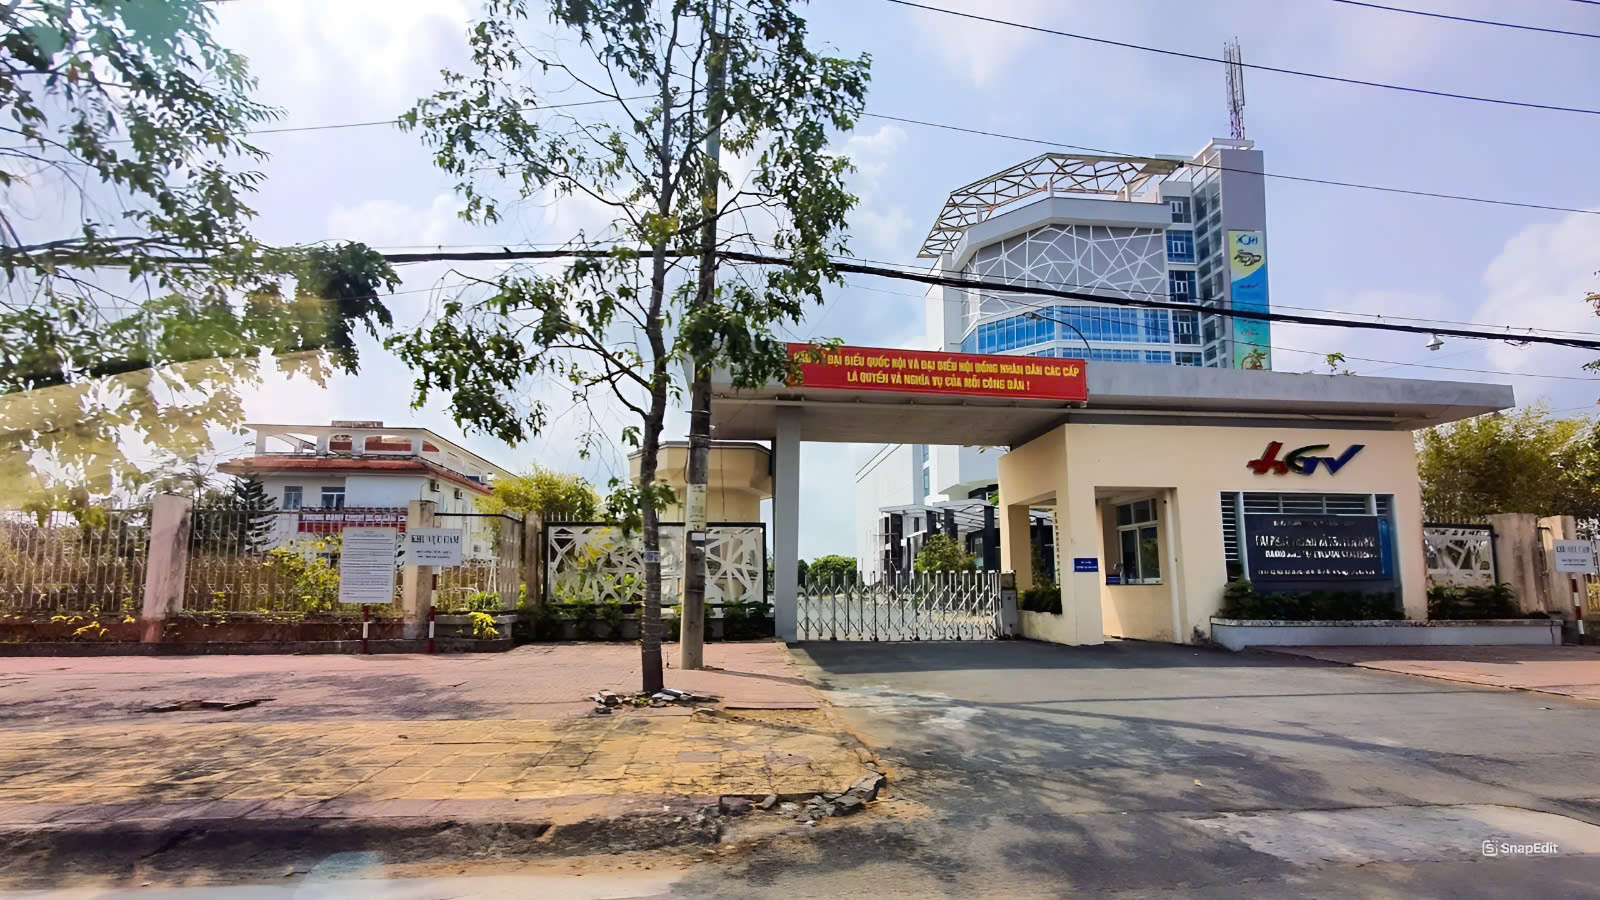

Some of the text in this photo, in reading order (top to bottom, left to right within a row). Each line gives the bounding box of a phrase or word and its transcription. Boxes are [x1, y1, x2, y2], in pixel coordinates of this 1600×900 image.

[827, 354, 842, 367] ĐẠI
[844, 352, 865, 366] BIỂU
[867, 354, 890, 367] QUỐC
[891, 356, 906, 370] HỘI
[907, 357, 920, 369] VÀ
[921, 359, 935, 372] ĐẠI
[937, 357, 957, 371] BIỂU
[958, 360, 973, 374] HỘI
[1000, 362, 1023, 375] NHÂN
[1025, 363, 1042, 376] DÂN
[1044, 365, 1061, 377] CÁC
[1063, 363, 1080, 377] CẤP
[847, 369, 858, 382] LÀ
[860, 370, 889, 383] QUYỀN
[890, 371, 902, 384] VÀ
[904, 373, 930, 385] NGHĨA
[932, 375, 943, 388] VỤ
[945, 373, 962, 387] CỦA
[963, 374, 980, 388] MỖI
[982, 377, 1005, 389] CÔNG
[1007, 378, 1025, 390] DÂN
